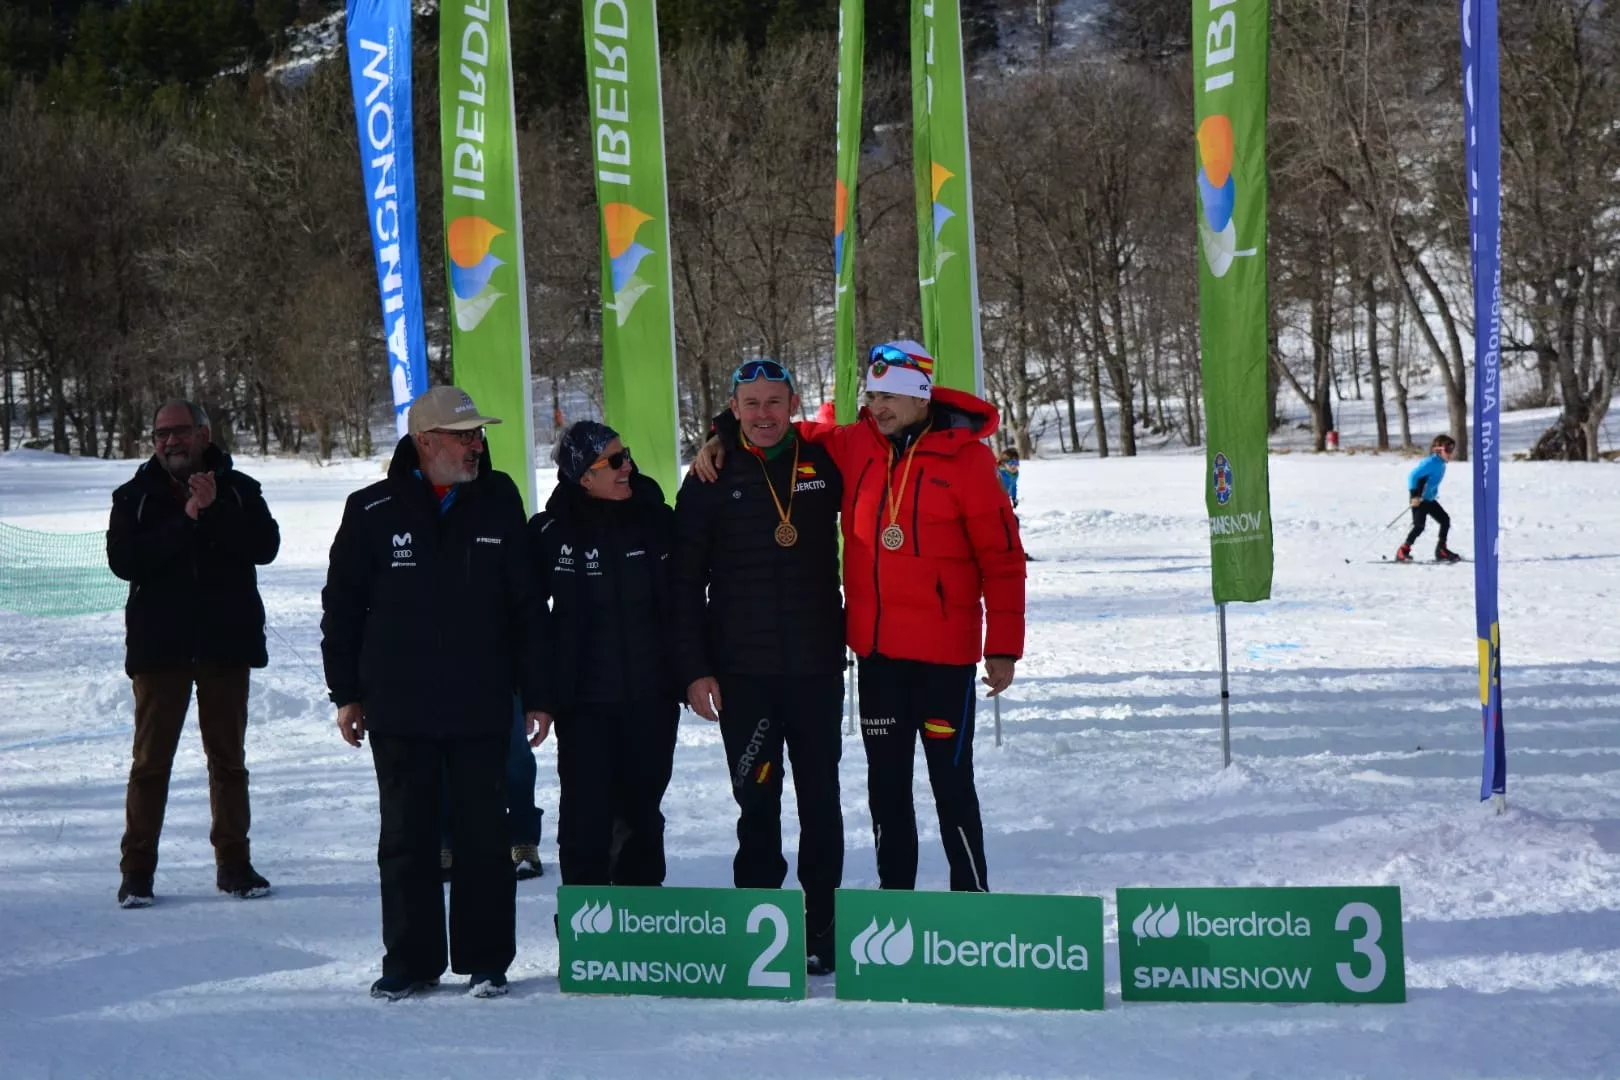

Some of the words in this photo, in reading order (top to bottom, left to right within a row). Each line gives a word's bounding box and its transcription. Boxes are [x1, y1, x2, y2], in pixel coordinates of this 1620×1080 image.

[866, 728, 889, 736] CIVIL
[618, 908, 726, 935] Iberdrola
[1186, 911, 1311, 937] Iberdrola
[746, 903, 791, 988] 2
[924, 930, 1088, 971] Iberdrola
[1334, 902, 1387, 993] 3
[571, 959, 726, 985] SPAINSNOW
[1133, 966, 1312, 989] SPAINSNOW
